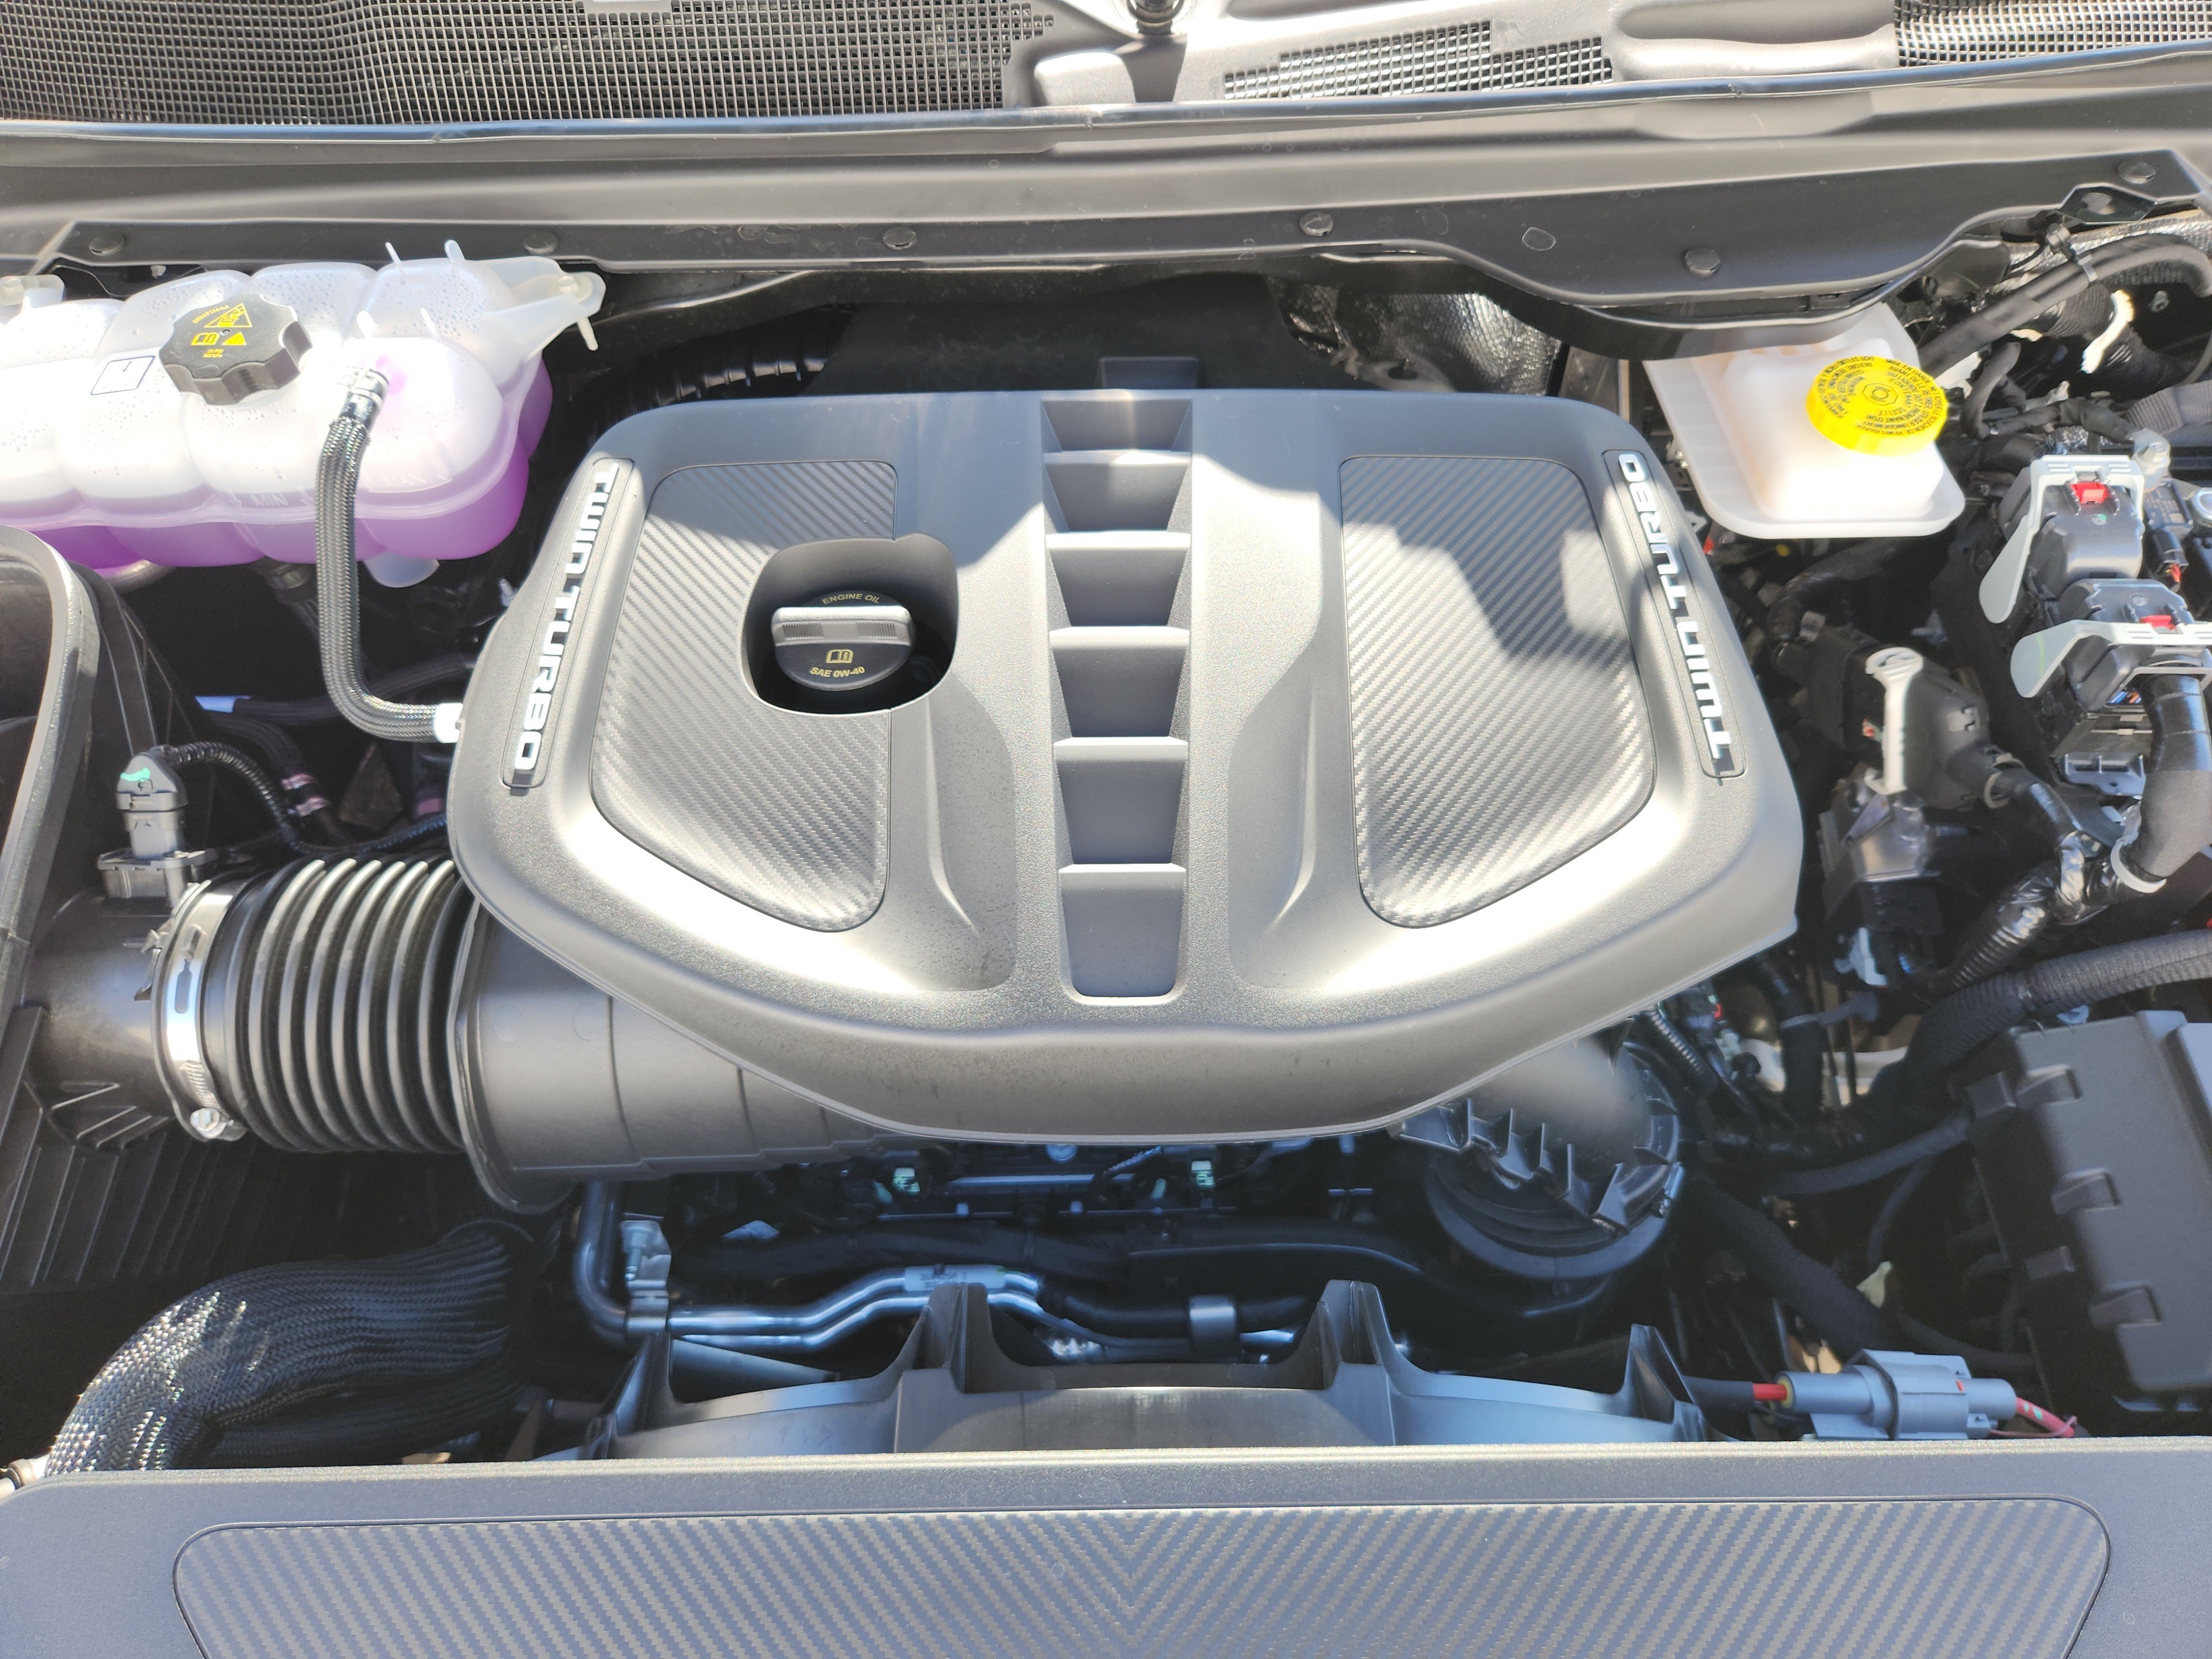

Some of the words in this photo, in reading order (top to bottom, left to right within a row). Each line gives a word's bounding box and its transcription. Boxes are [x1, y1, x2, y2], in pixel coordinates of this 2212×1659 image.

[249, 493, 289, 507] MIN
[565, 462, 619, 574] TWIN
[1618, 453, 1687, 609] TURBO
[822, 593, 863, 605] ENGINE
[864, 594, 880, 604] OIL
[514, 585, 580, 770] TURBO
[810, 667, 831, 677] SAE
[833, 666, 865, 678] 0W-40
[1677, 621, 1731, 759] TWIN
